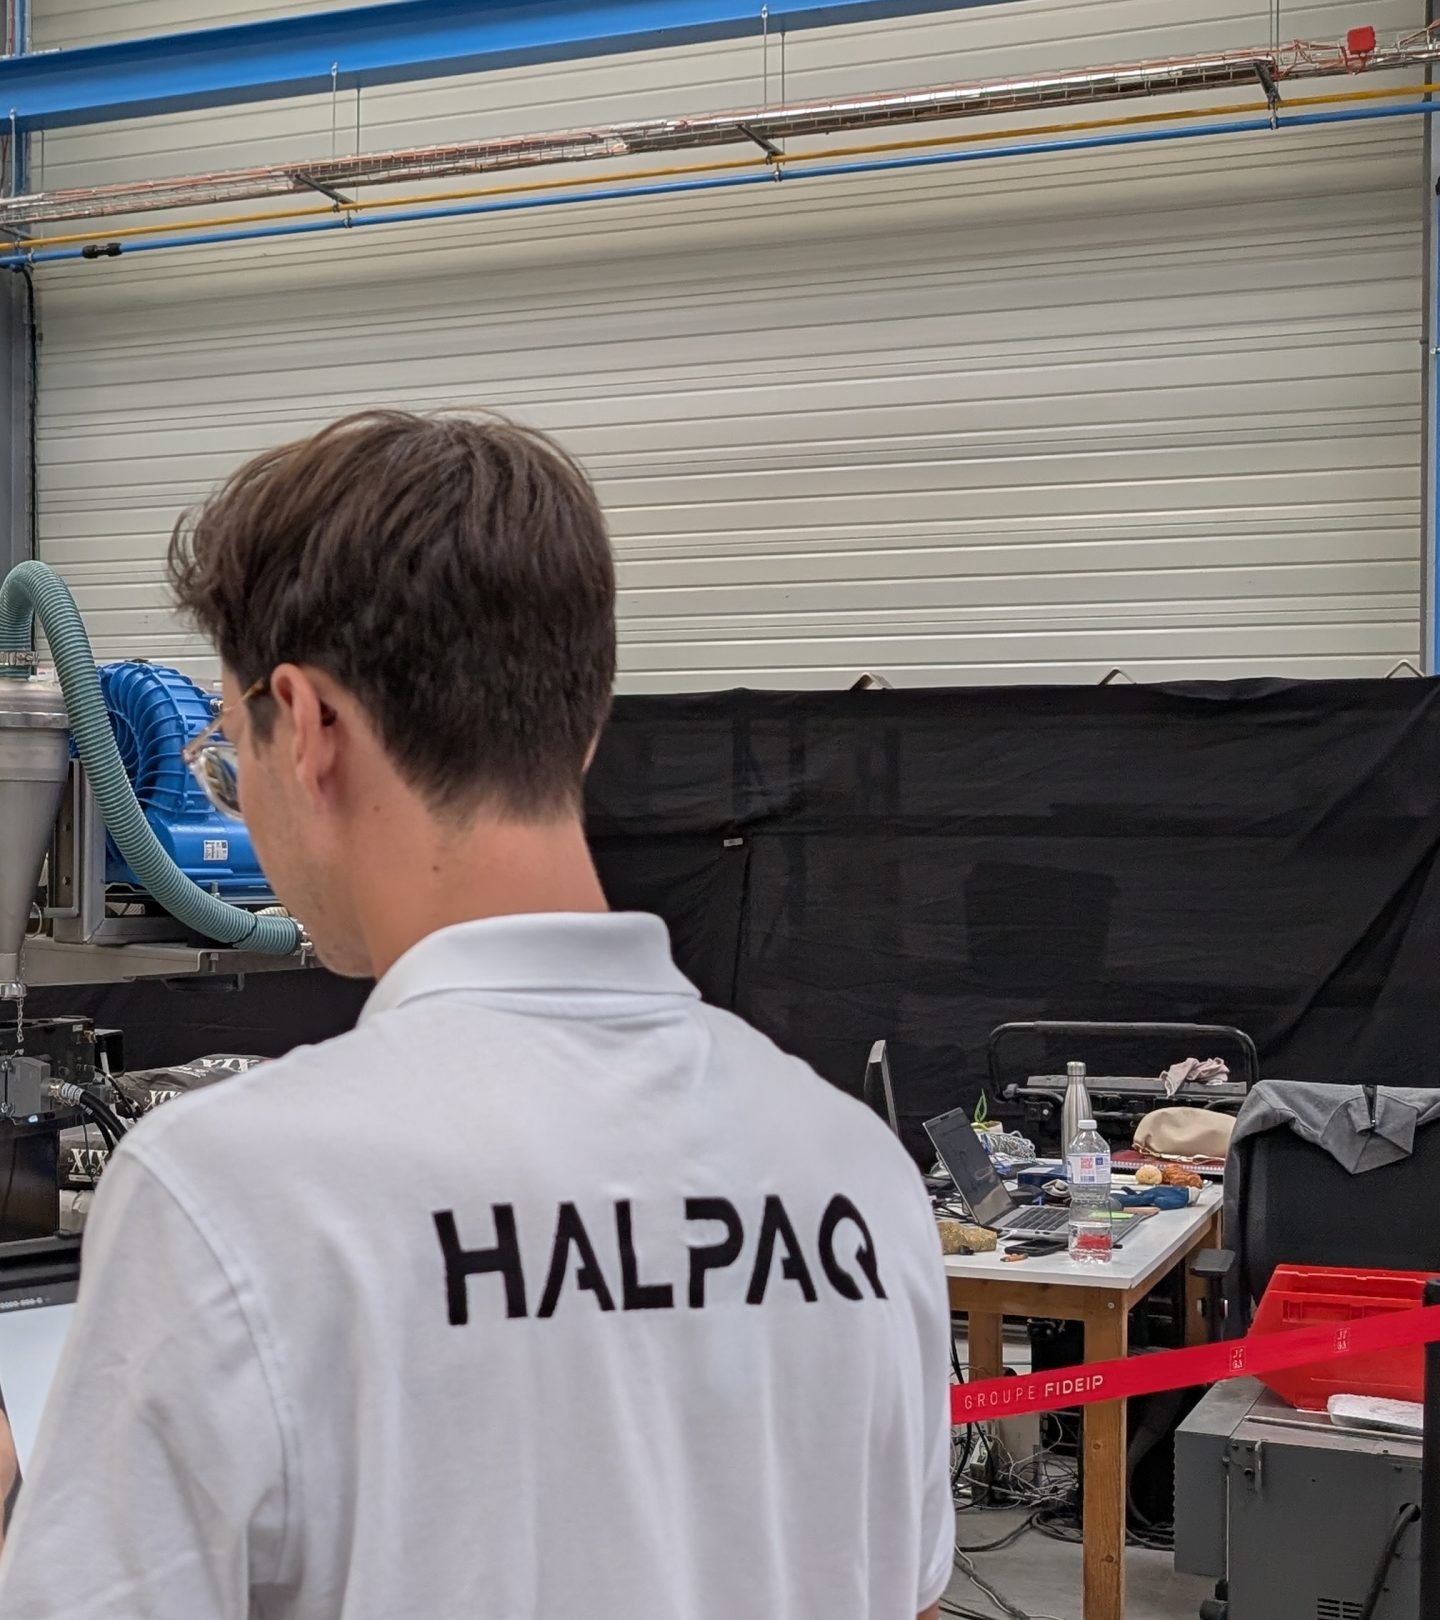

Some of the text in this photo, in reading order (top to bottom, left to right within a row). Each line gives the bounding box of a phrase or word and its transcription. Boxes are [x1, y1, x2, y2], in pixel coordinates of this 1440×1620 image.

[432, 1193, 888, 1325] HALPAQ
[964, 1374, 1104, 1410] GROUPE FIDEIP
